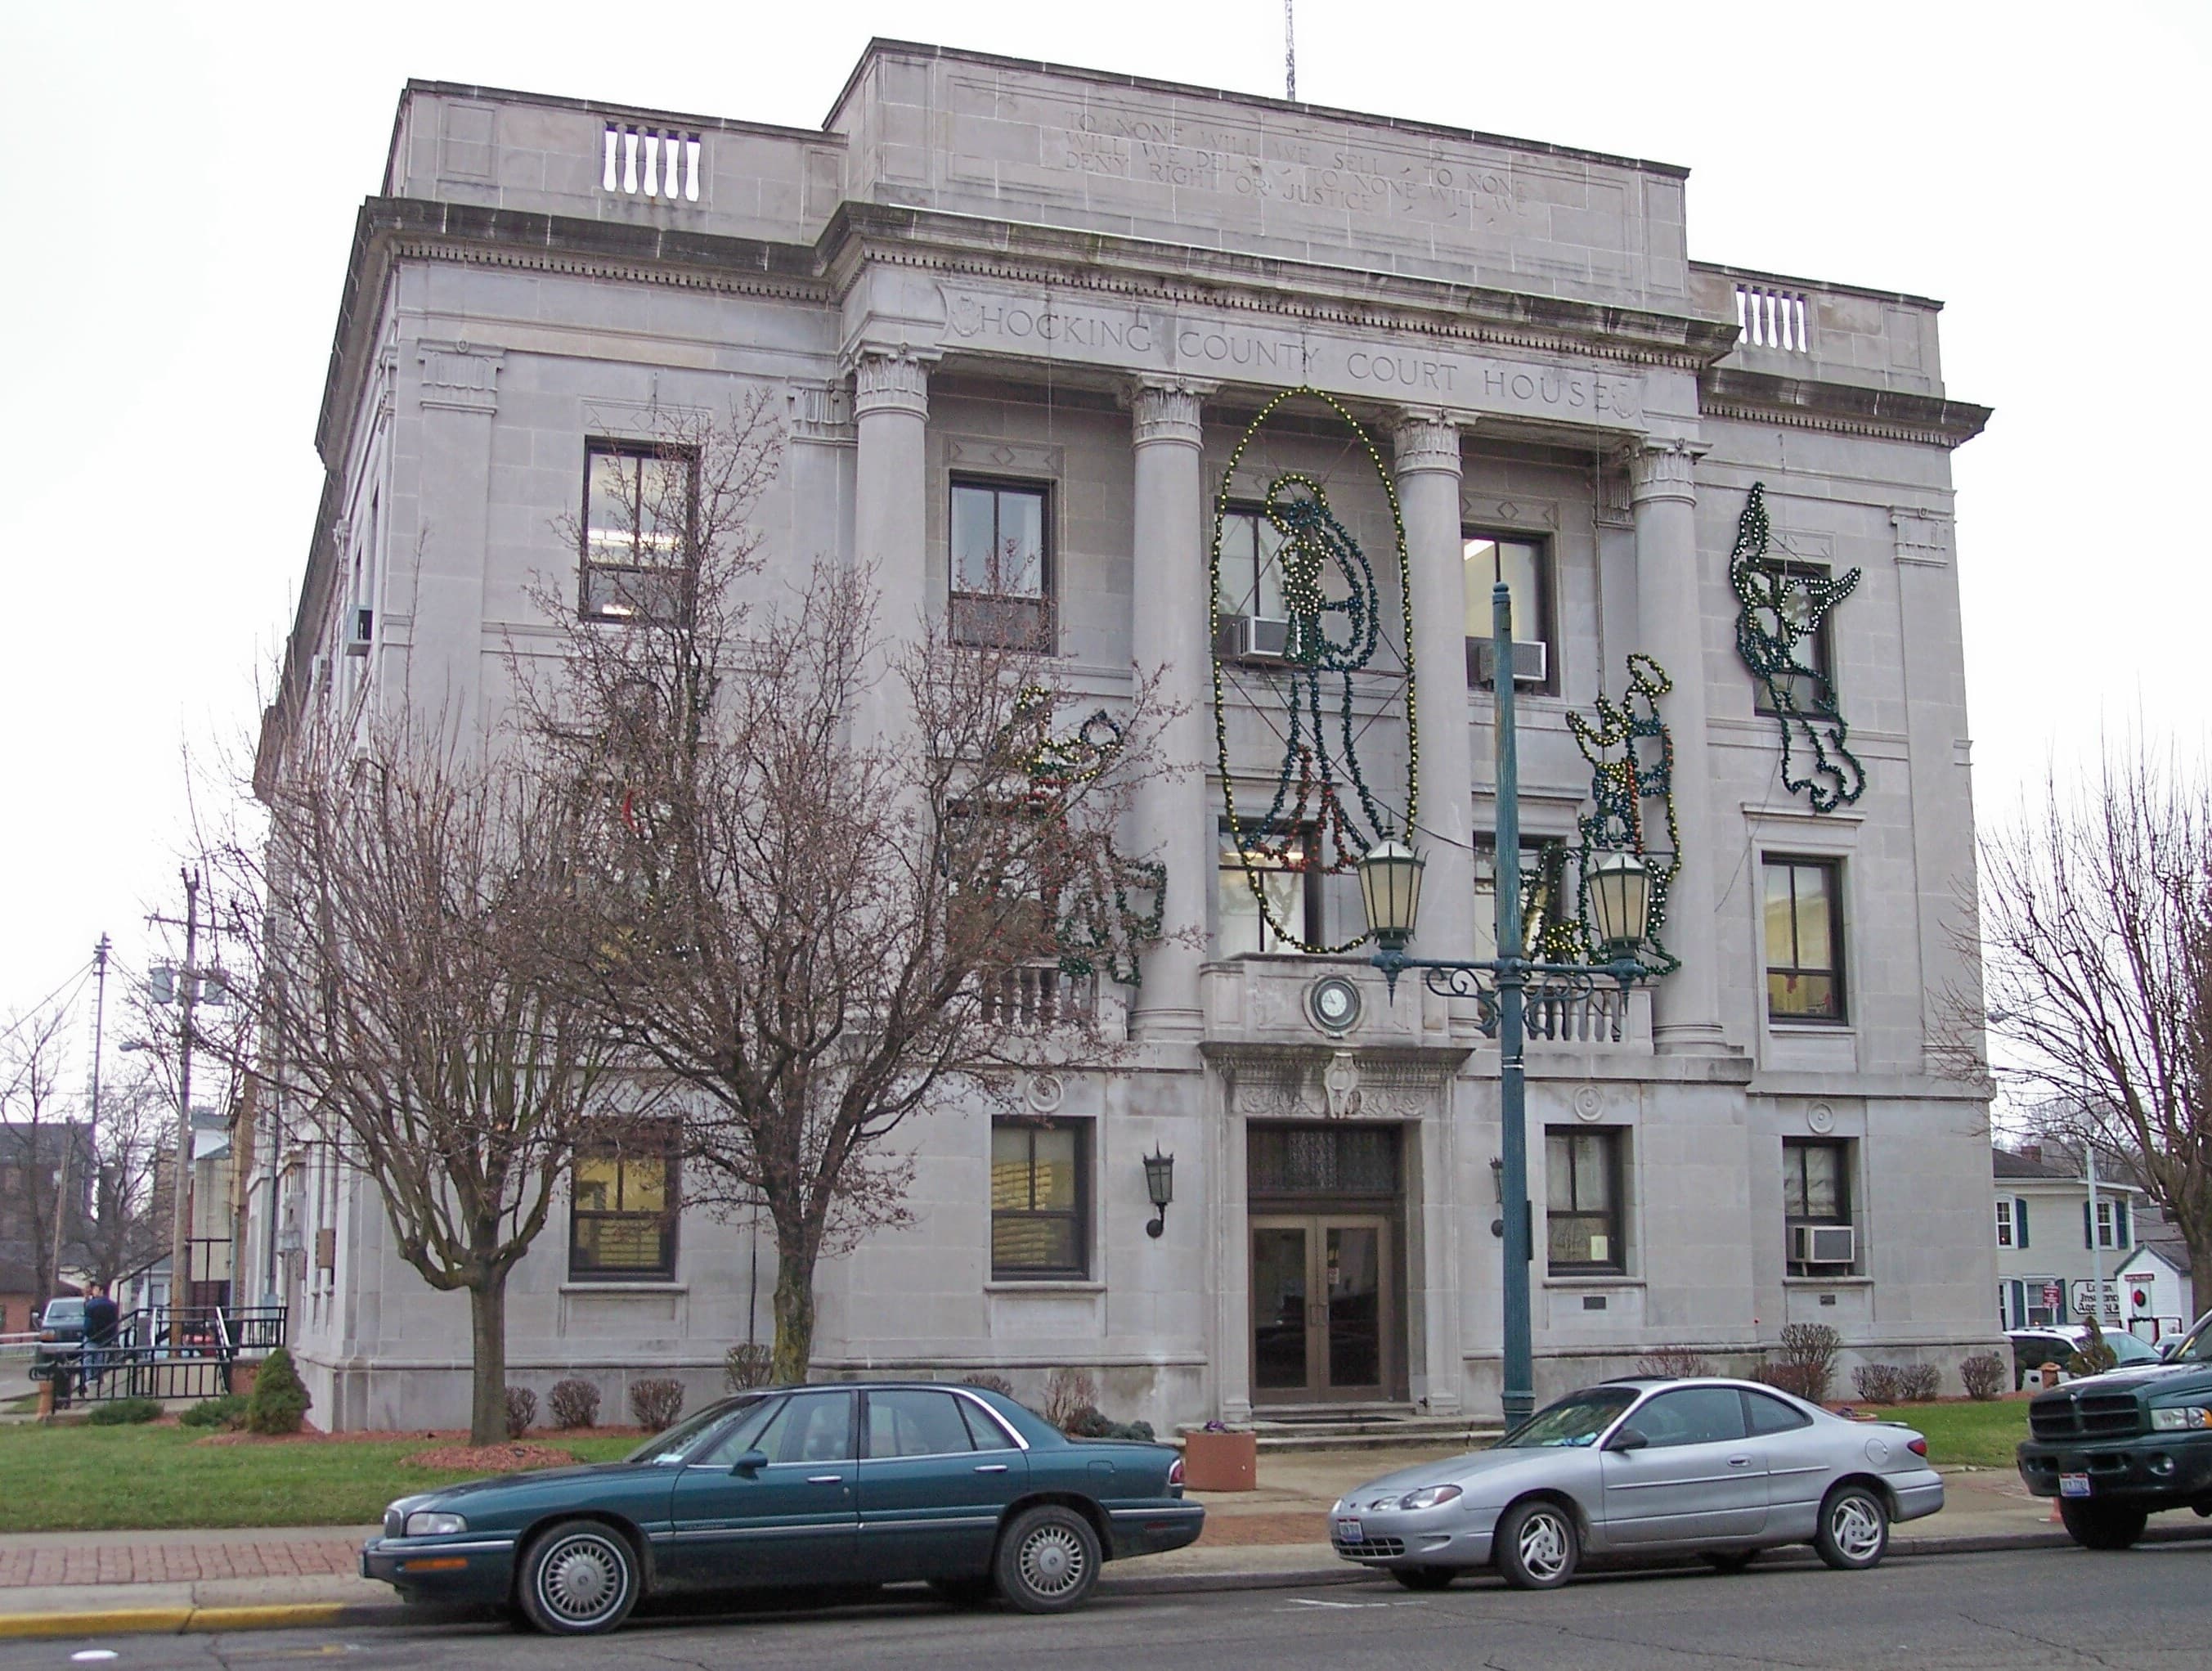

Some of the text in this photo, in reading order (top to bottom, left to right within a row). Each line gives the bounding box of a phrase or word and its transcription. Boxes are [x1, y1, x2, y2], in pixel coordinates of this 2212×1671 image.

[1065, 111, 1097, 133] TO
[1116, 118, 1183, 145] NONE
[1200, 131, 1260, 158] WILL
[1275, 142, 1311, 165] WE
[1424, 166, 1453, 187] TO
[1466, 172, 1528, 204] NONE
[1065, 150, 1129, 178] DENY
[1149, 163, 1219, 192] RIGHT
[1066, 130, 1125, 157] WILL
[1142, 141, 1181, 164] WE
[1308, 167, 1339, 188] TO
[1354, 173, 1417, 200] NONE
[1429, 187, 1483, 210] WILL
[1495, 195, 1528, 217] WE
[980, 305, 1610, 412] HOCKING COUNTY COURT HOUSE
